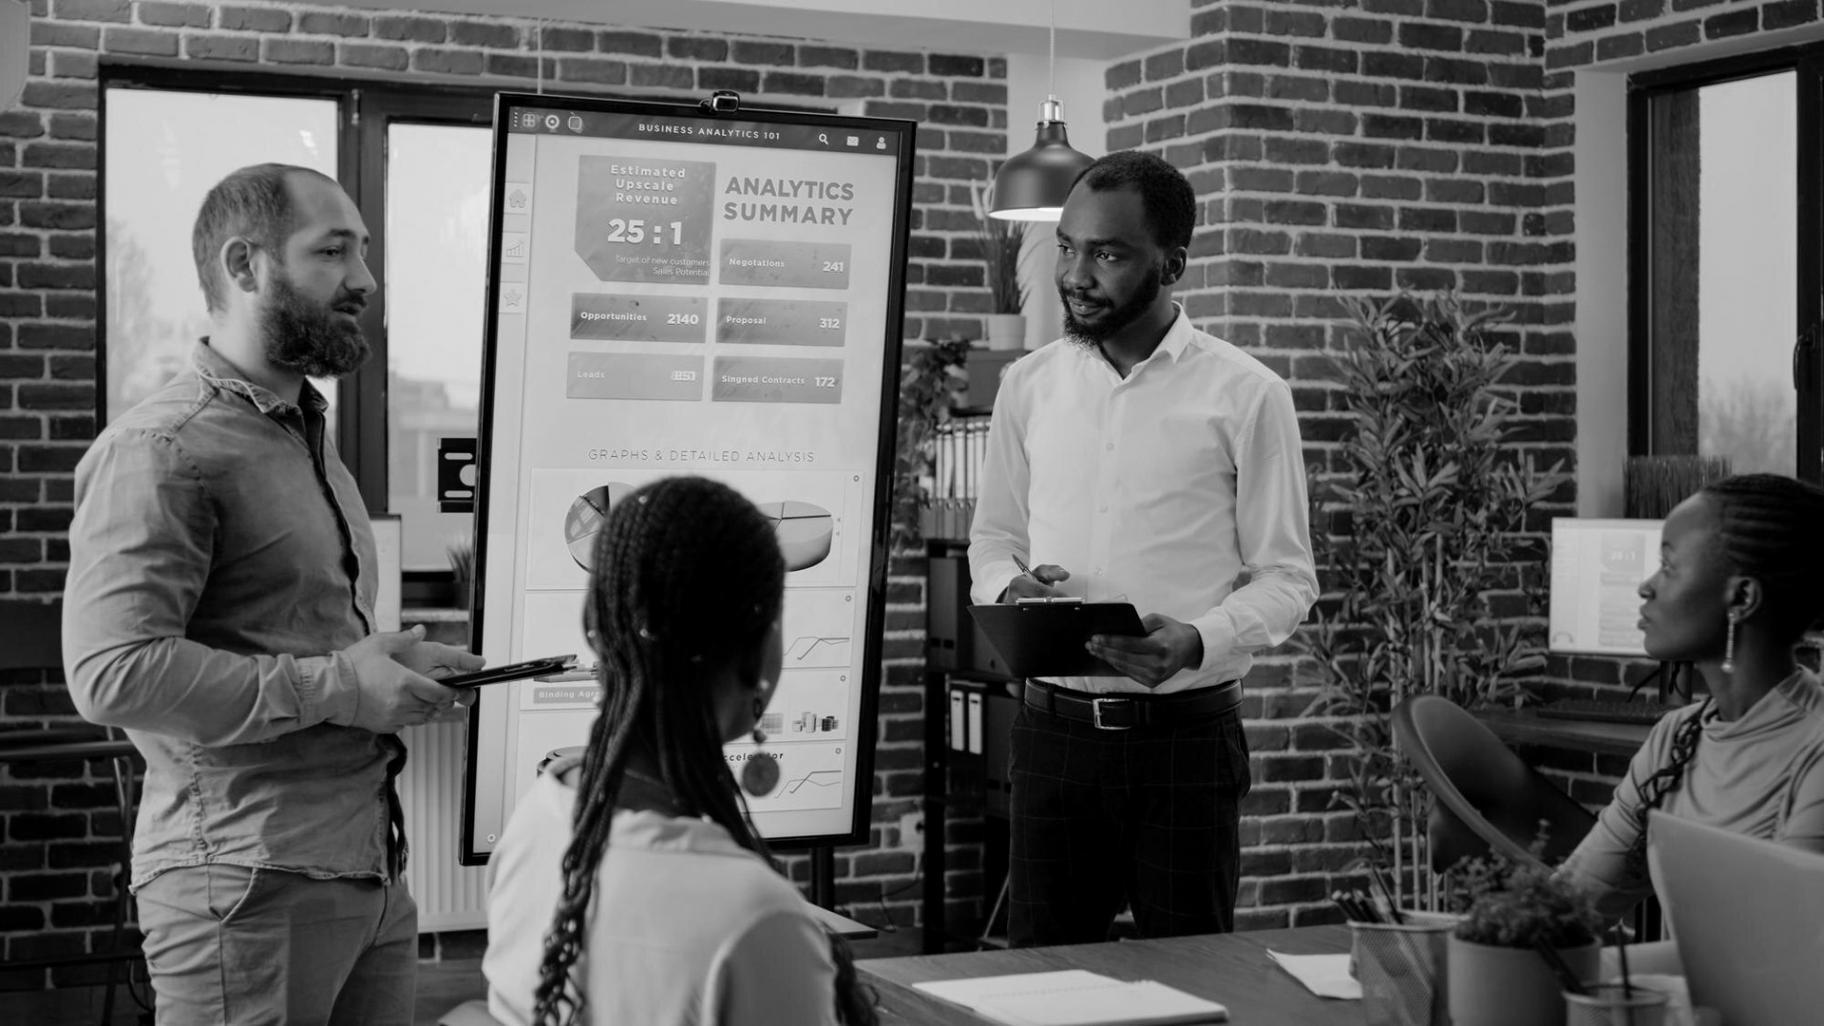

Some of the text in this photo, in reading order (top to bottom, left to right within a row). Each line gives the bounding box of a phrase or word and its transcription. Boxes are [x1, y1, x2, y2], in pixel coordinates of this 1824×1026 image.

[639, 123, 780, 140] BUSINESS ANALYTICS 101
[610, 164, 686, 178] Estimated
[616, 178, 674, 191] Upscale
[725, 176, 854, 201] ANALYTICS
[616, 192, 678, 205] Revenue
[723, 201, 854, 226] SUMMARY
[822, 260, 844, 273] 241
[580, 311, 648, 321] Opportunities
[666, 312, 700, 326] 2140
[726, 315, 767, 325] Proposal
[819, 317, 841, 329] 312
[761, 375, 805, 385] Contracts
[815, 376, 836, 388] 172
[588, 449, 815, 463] GRAPHS & DETAILED ANALYSIS
